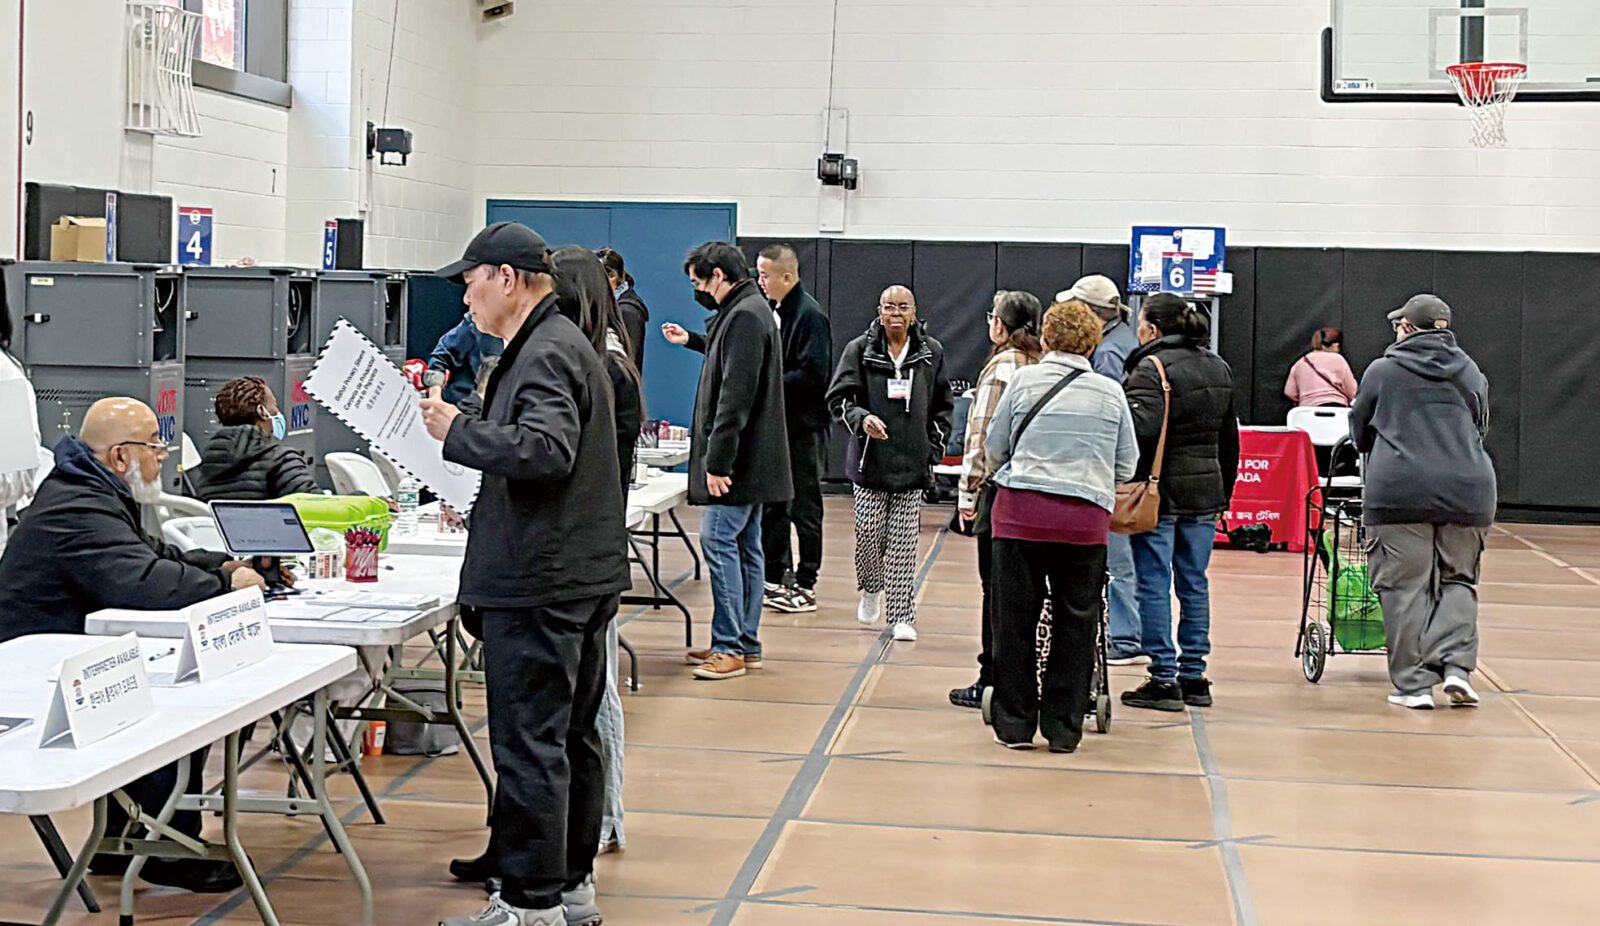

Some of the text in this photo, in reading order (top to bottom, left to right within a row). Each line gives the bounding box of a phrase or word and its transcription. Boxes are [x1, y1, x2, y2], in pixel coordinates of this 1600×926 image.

[26, 110, 33, 145] 9
[186, 230, 203, 260] 4
[325, 242, 333, 266] 5
[1169, 267, 1185, 288] 6
[334, 385, 347, 401] Ballot
[343, 366, 358, 385] Privacy
[291, 404, 309, 428] NYC
[158, 416, 176, 441] NYC
[1244, 459, 1269, 470] POR
